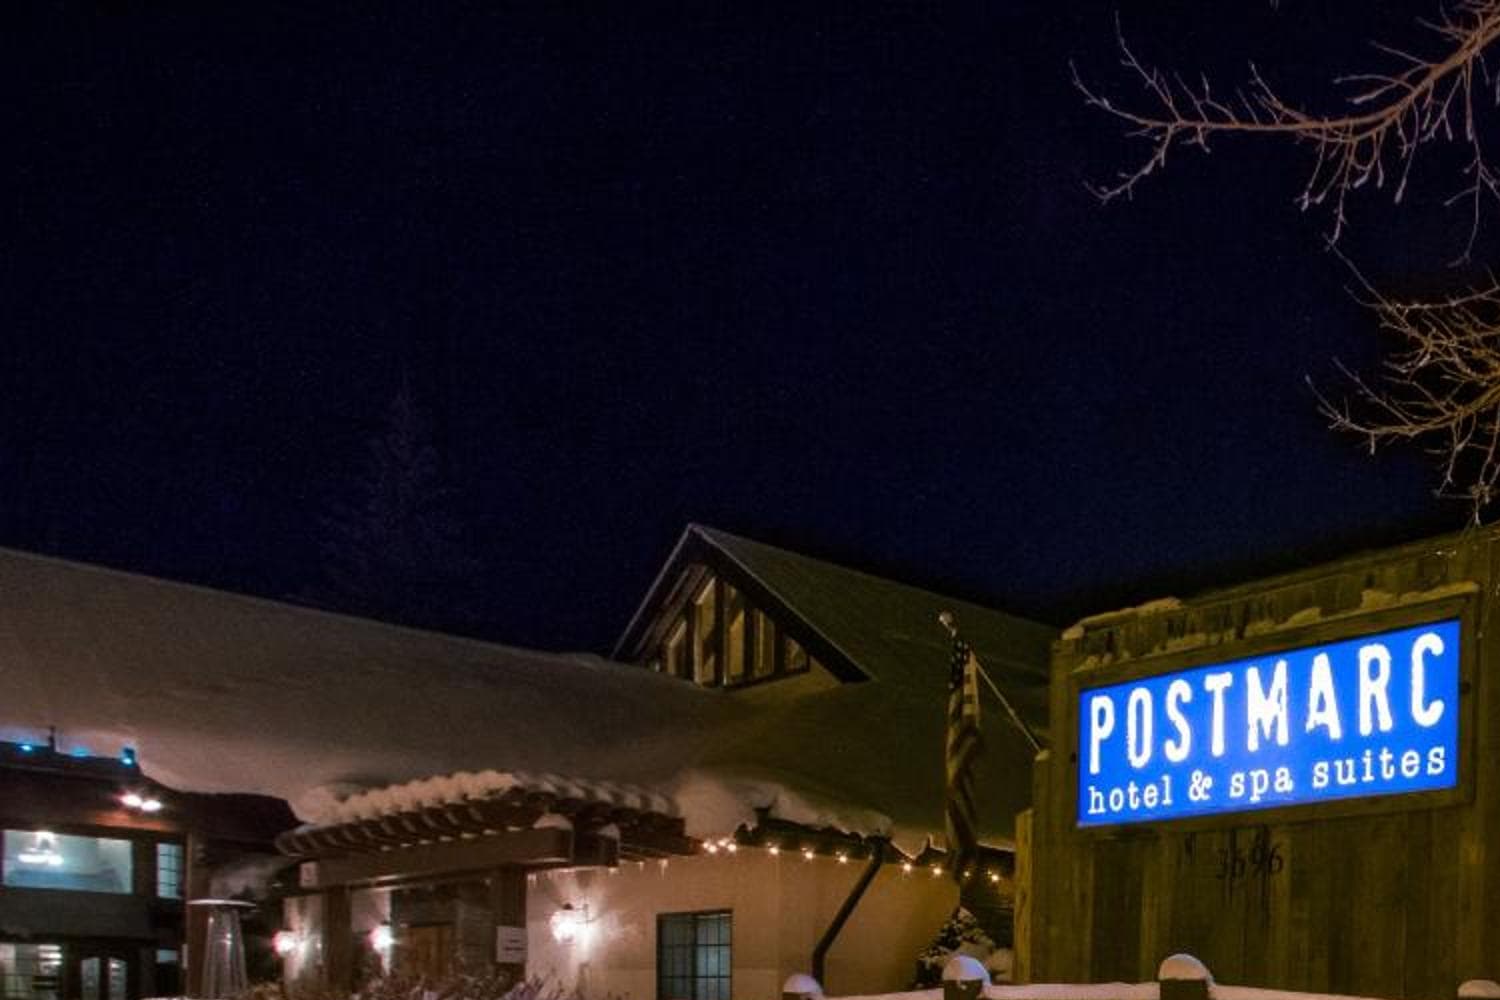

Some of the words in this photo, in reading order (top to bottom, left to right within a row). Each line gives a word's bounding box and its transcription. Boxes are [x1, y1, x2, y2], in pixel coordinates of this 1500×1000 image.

[1089, 632, 1445, 774] POSTMARC
[1087, 775, 1173, 814] hotel
[1188, 770, 1213, 801] &
[1229, 766, 1294, 801] spa
[1312, 746, 1446, 787] suites
